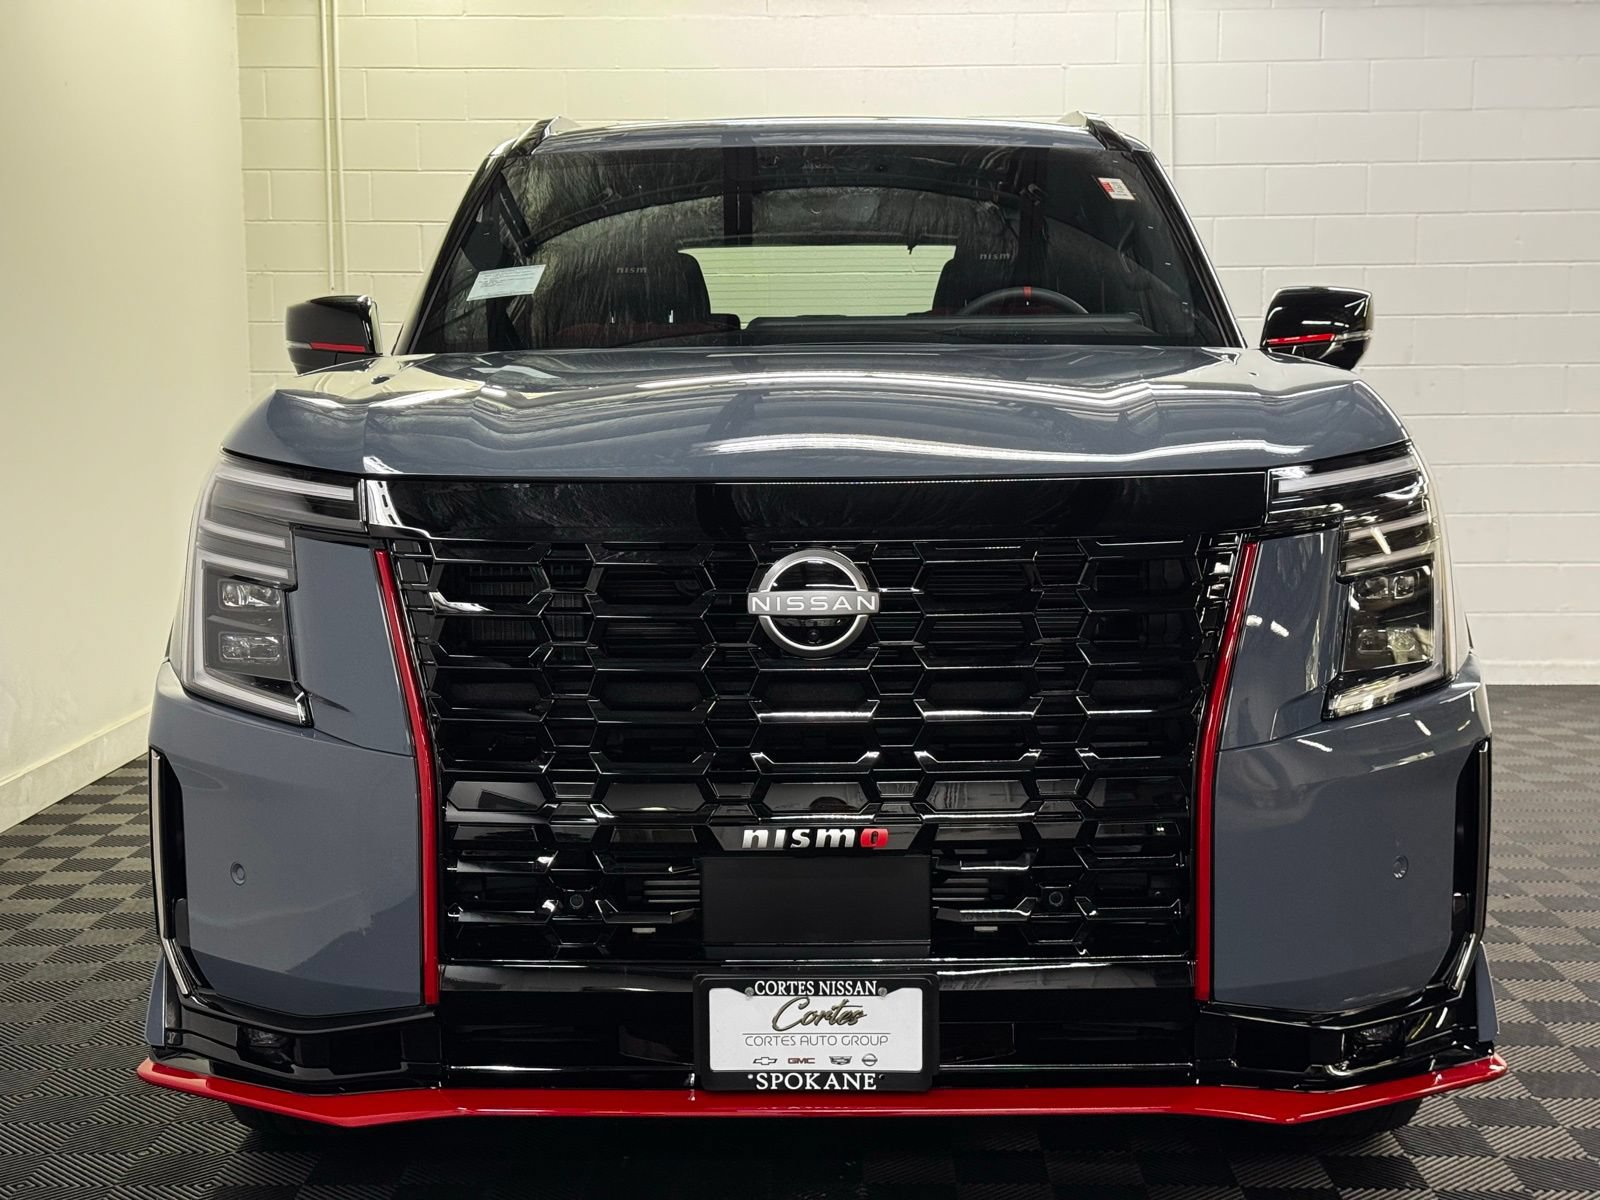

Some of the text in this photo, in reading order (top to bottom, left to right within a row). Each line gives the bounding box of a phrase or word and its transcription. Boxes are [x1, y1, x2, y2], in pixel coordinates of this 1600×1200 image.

[752, 595, 876, 611] NISSAN
[741, 828, 889, 848] nismo
[754, 980, 877, 996] CORTES NISSAN
[771, 996, 867, 1032] Cortes
[745, 1035, 889, 1047] CORTES AUTO GROUP
[787, 1057, 816, 1065] GMC
[756, 1072, 877, 1090] SPOKANE
